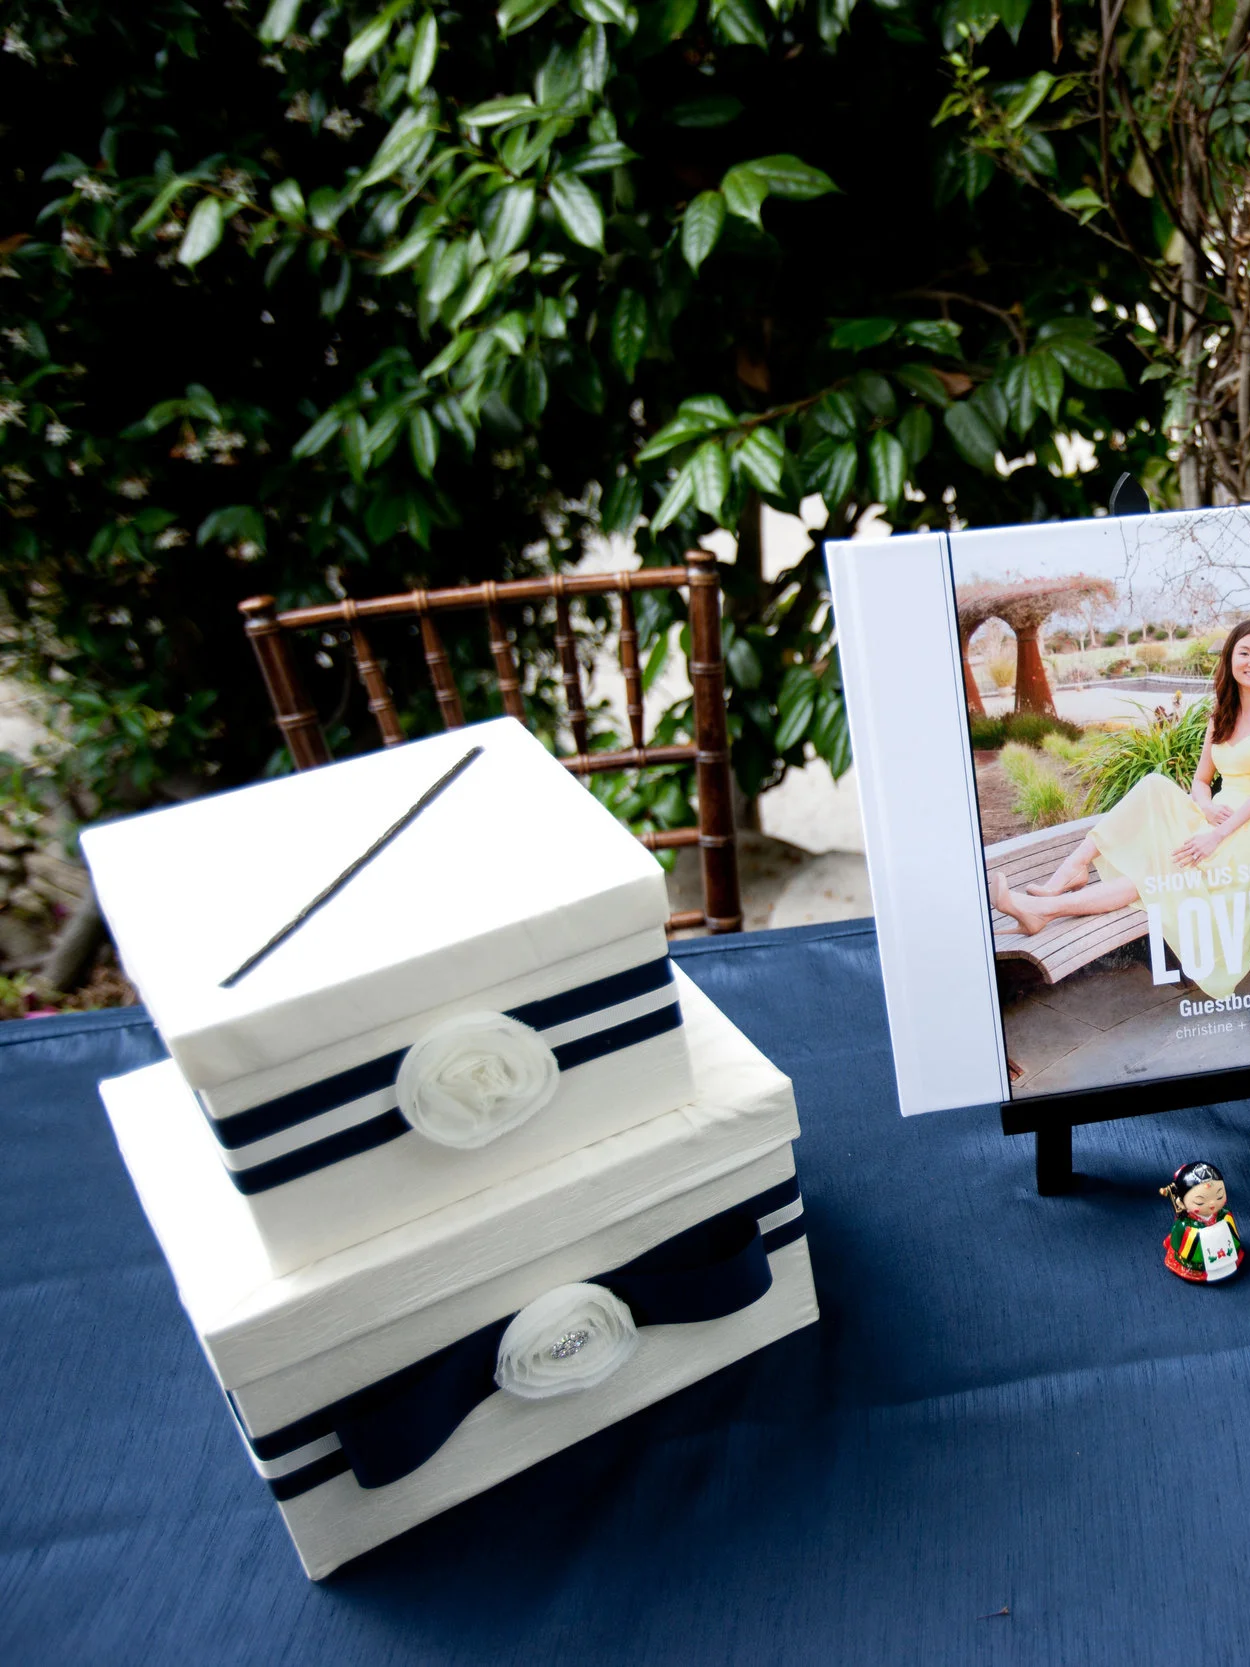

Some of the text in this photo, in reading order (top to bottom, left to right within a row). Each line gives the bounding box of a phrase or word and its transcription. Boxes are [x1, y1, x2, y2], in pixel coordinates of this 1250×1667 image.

[1144, 870, 1202, 894] SHOW
[1207, 866, 1233, 886] US
[1176, 1021, 1234, 1040] christine
